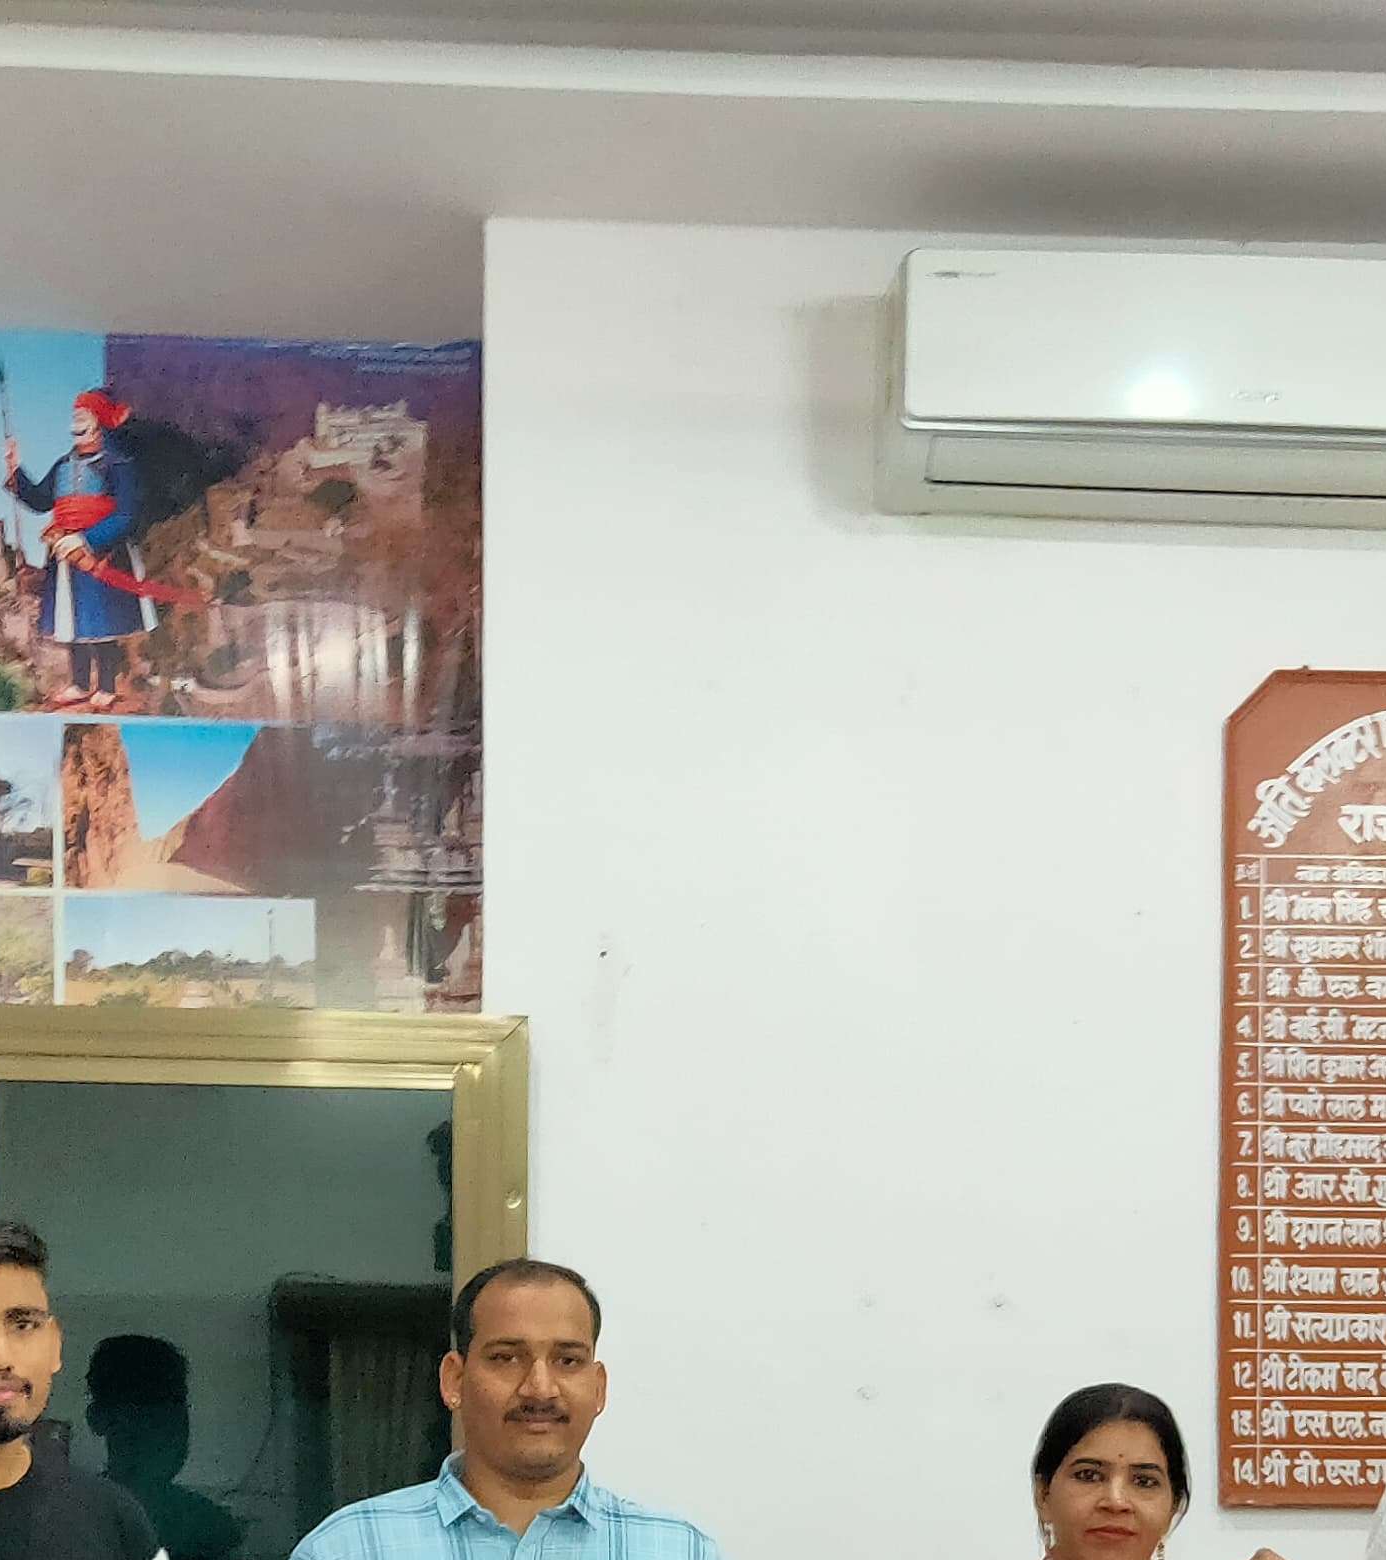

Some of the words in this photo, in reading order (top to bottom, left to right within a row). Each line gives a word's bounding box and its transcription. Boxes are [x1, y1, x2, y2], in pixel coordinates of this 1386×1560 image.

[1263, 1258, 1289, 1294] श्री
[1263, 1304, 1292, 1342] श्री
[1261, 1353, 1286, 1392] श्री
